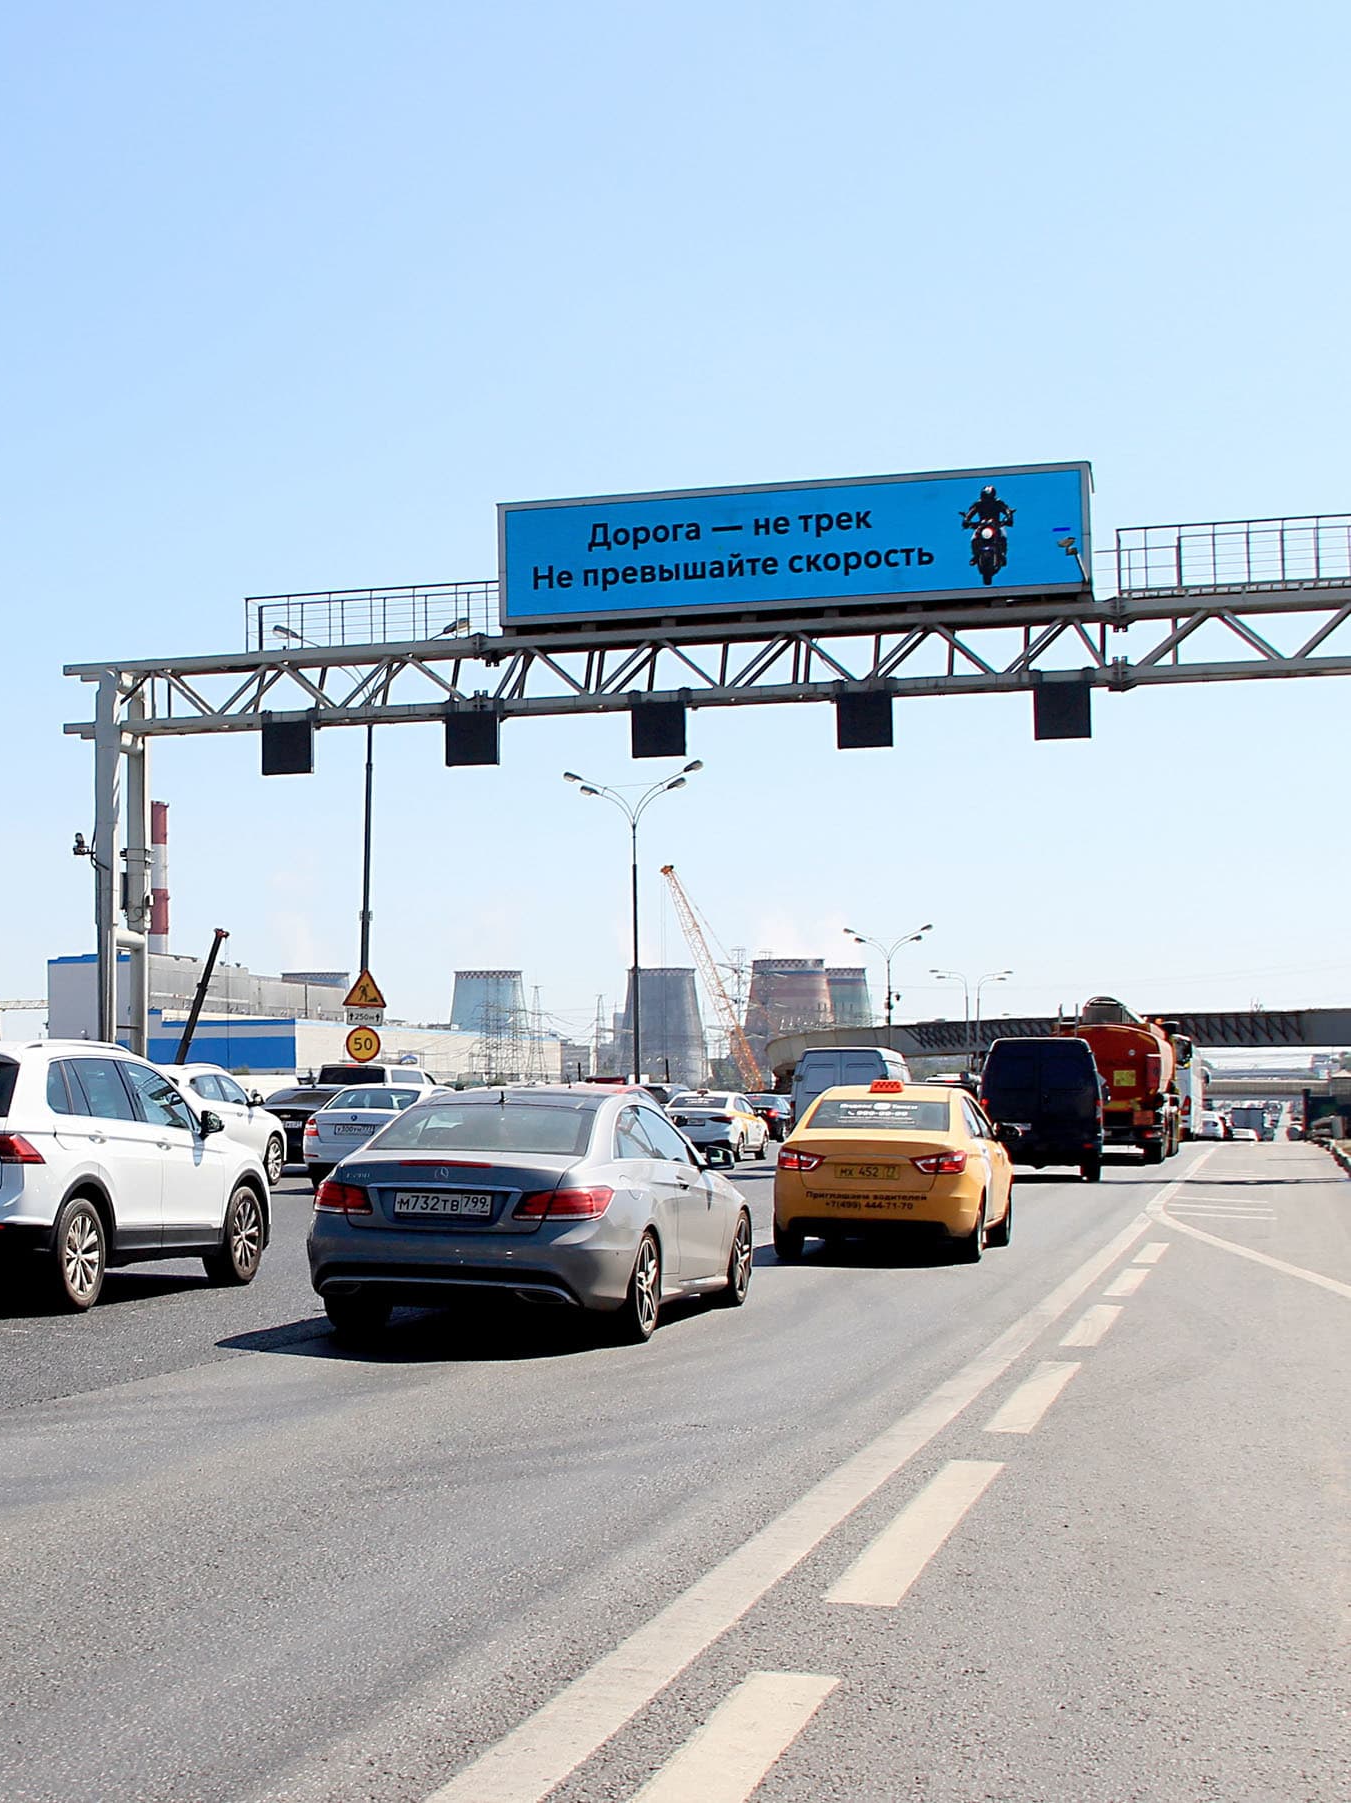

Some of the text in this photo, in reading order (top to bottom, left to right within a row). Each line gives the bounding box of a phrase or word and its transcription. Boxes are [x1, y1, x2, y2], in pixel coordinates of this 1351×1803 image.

[587, 522, 701, 552] Дорога
[753, 515, 790, 536] не
[798, 510, 873, 538] трек
[532, 547, 935, 592] Не превышайте скорость
[353, 1037, 373, 1051] 50
[858, 1167, 879, 1177] 452
[399, 1195, 459, 1212] М732ТВ
